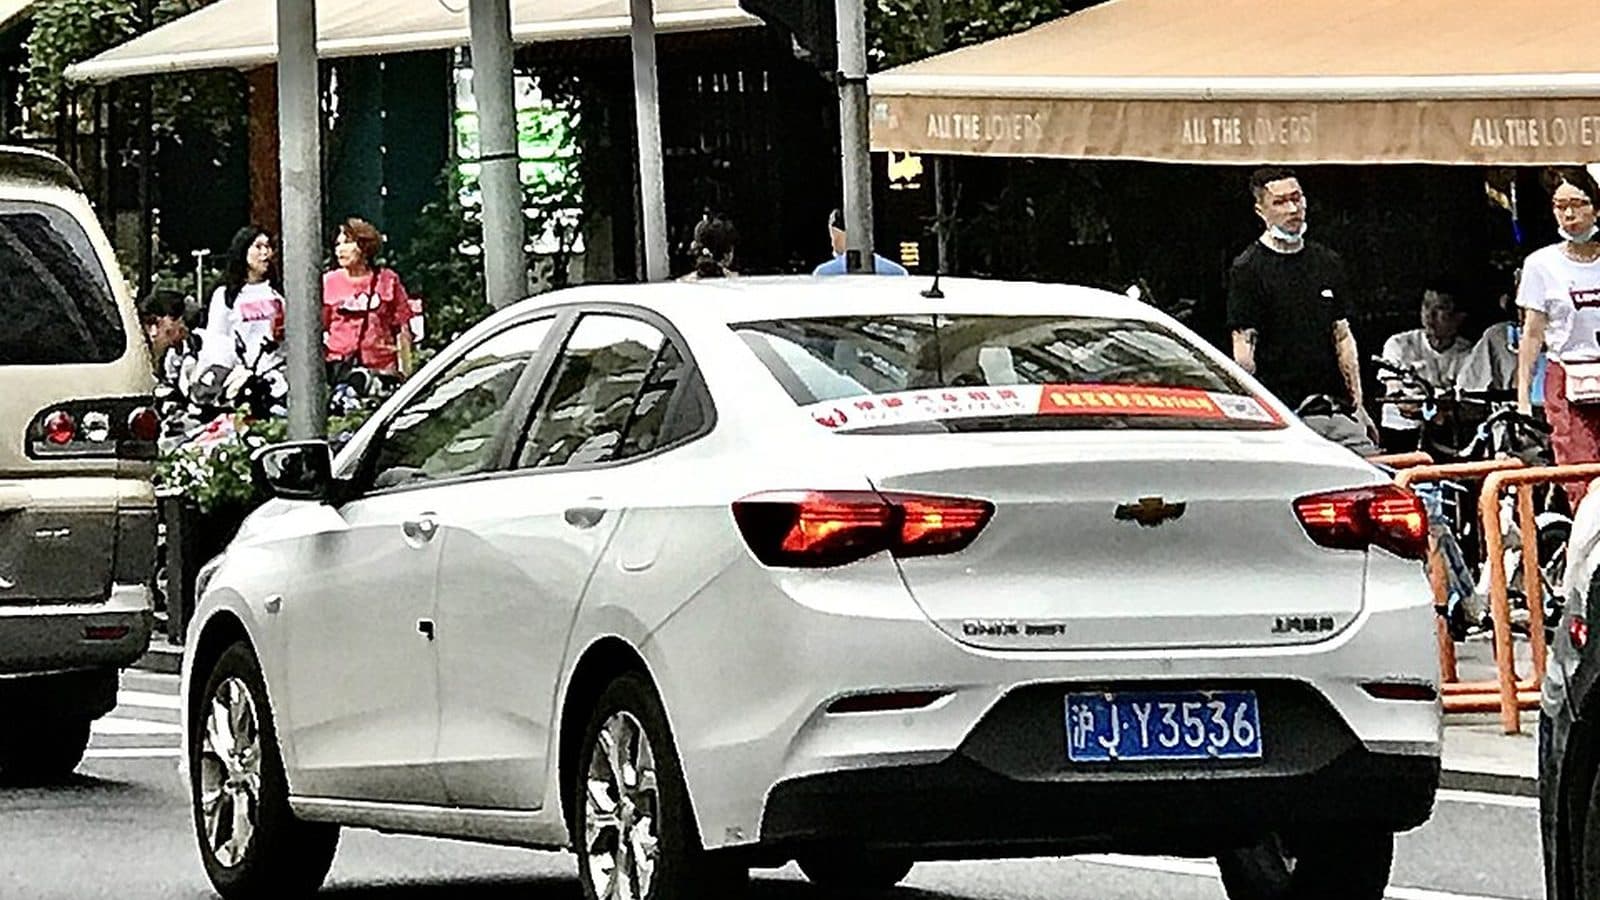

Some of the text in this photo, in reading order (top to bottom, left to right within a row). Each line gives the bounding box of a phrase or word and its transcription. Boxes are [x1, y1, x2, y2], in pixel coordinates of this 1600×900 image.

[926, 113, 952, 138] ALL
[953, 113, 980, 140] THE
[1181, 117, 1207, 144] ALL
[1212, 117, 1242, 144] THE
[1470, 117, 1503, 147] ALL
[1504, 117, 1539, 146] THE
